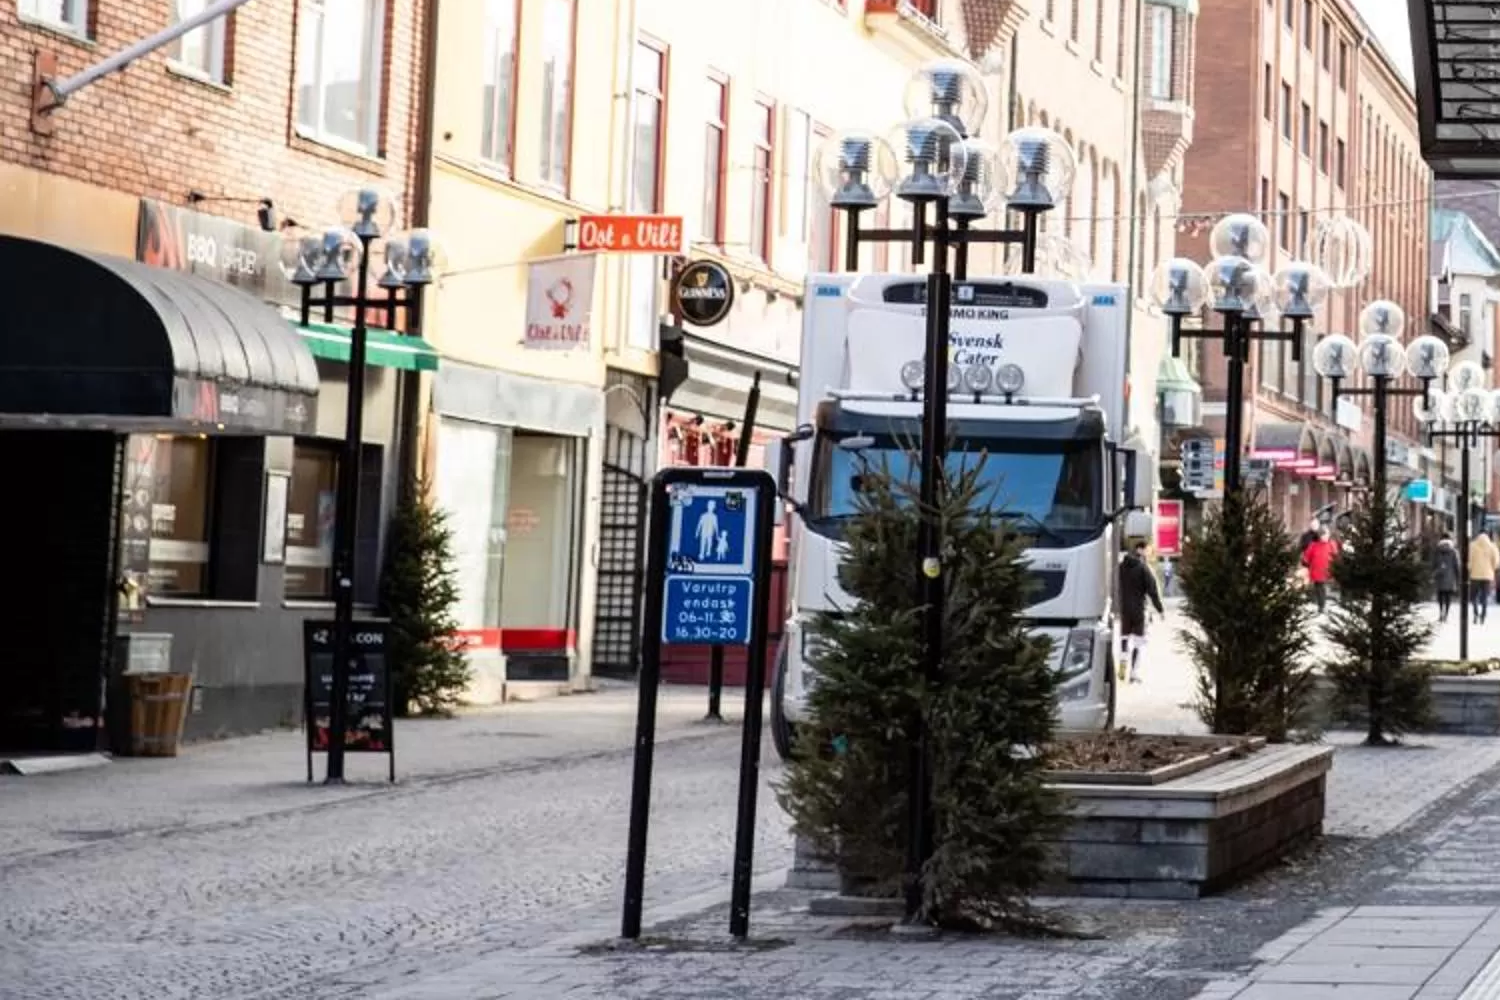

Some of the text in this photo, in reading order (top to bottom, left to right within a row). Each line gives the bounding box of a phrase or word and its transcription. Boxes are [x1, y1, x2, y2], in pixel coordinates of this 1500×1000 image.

[581, 220, 615, 248] Ost
[636, 220, 680, 248] Vilt
[187, 232, 217, 267] BBQ
[679, 286, 725, 299] GUINNESS
[978, 309, 1009, 320] KING
[948, 332, 1003, 349] Svensk
[953, 349, 999, 365] Cater
[682, 582, 737, 595] Varutrp
[675, 627, 737, 639] 16.30-20
